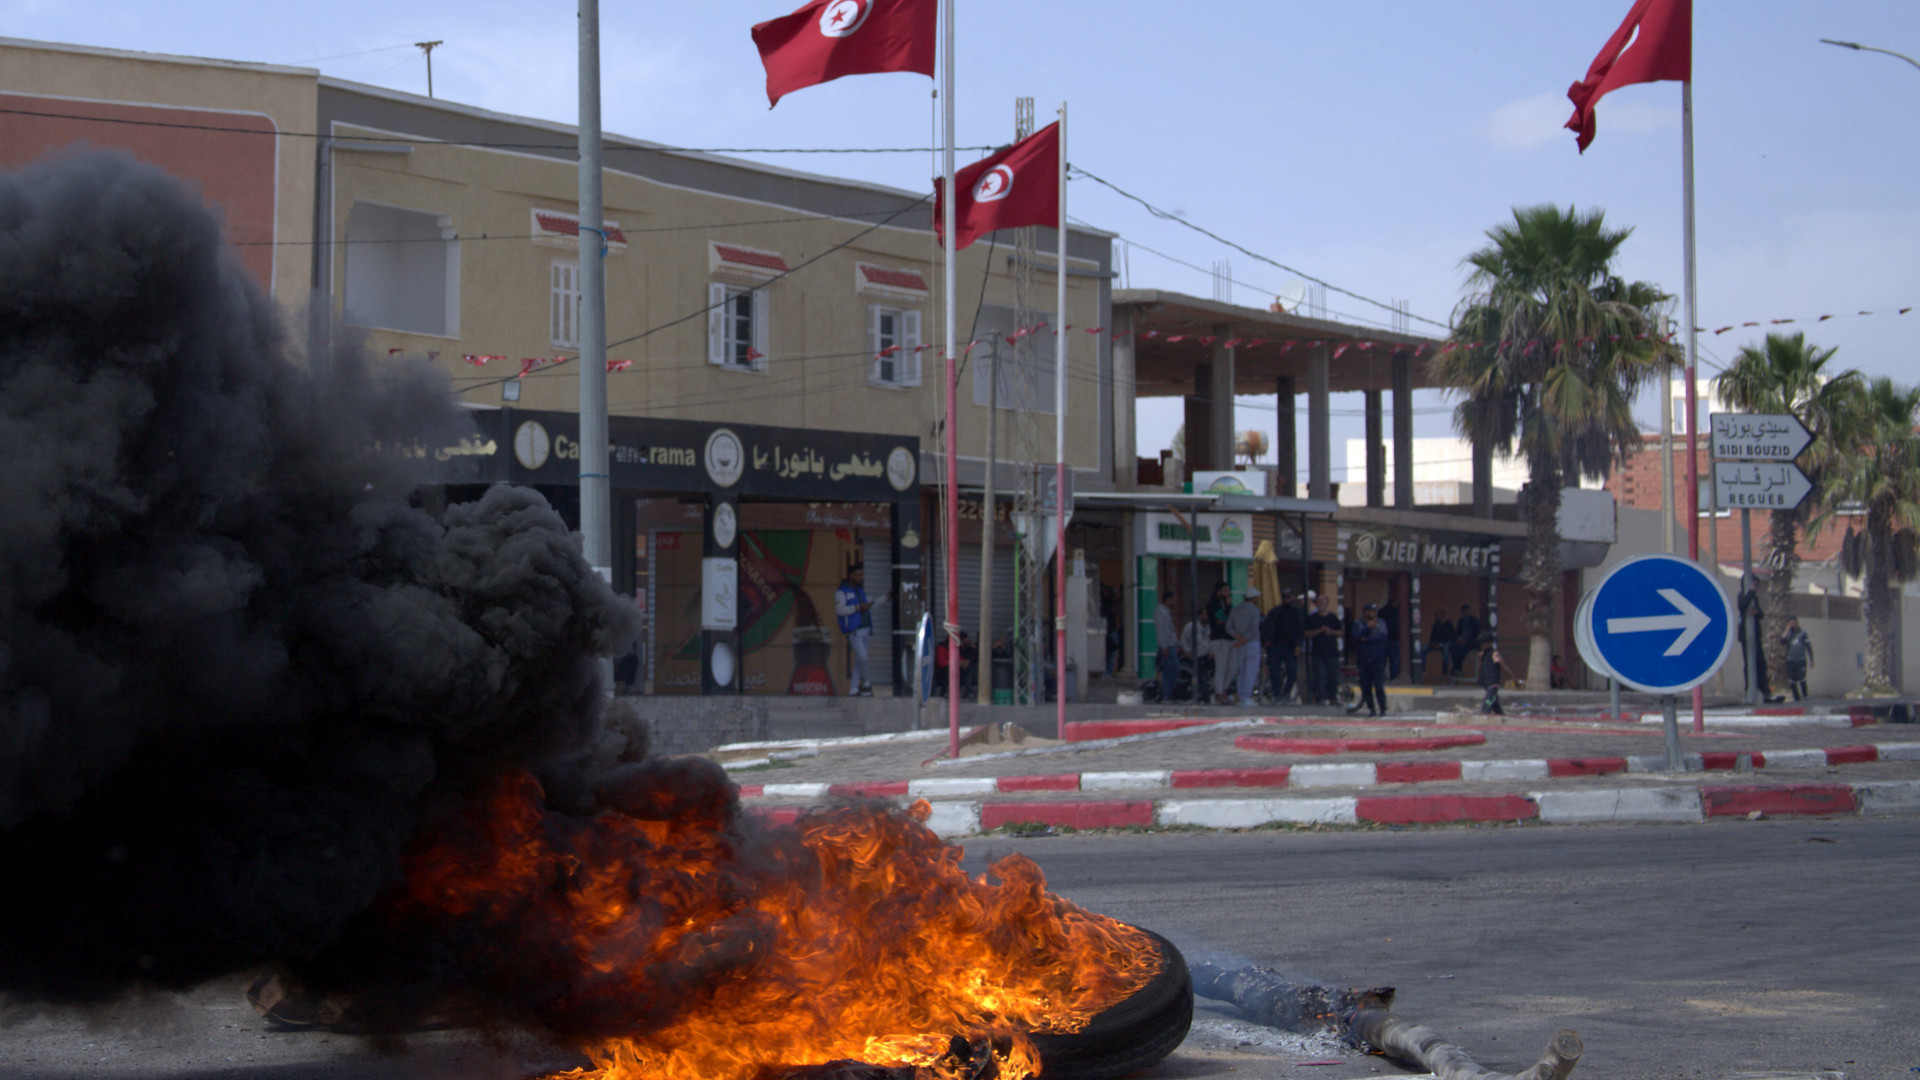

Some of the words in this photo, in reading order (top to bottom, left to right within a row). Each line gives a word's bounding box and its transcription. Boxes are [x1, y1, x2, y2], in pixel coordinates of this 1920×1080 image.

[1717, 417, 1751, 439] بوزيد
[1751, 421, 1790, 442] سيدي
[554, 434, 580, 460] Ca
[1719, 444, 1743, 456] SIDI
[1746, 445, 1791, 456] BOUZID
[1729, 493, 1785, 505] REGUEB
[1382, 540, 1417, 563] ZIED
[1423, 543, 1491, 568] MARKET
